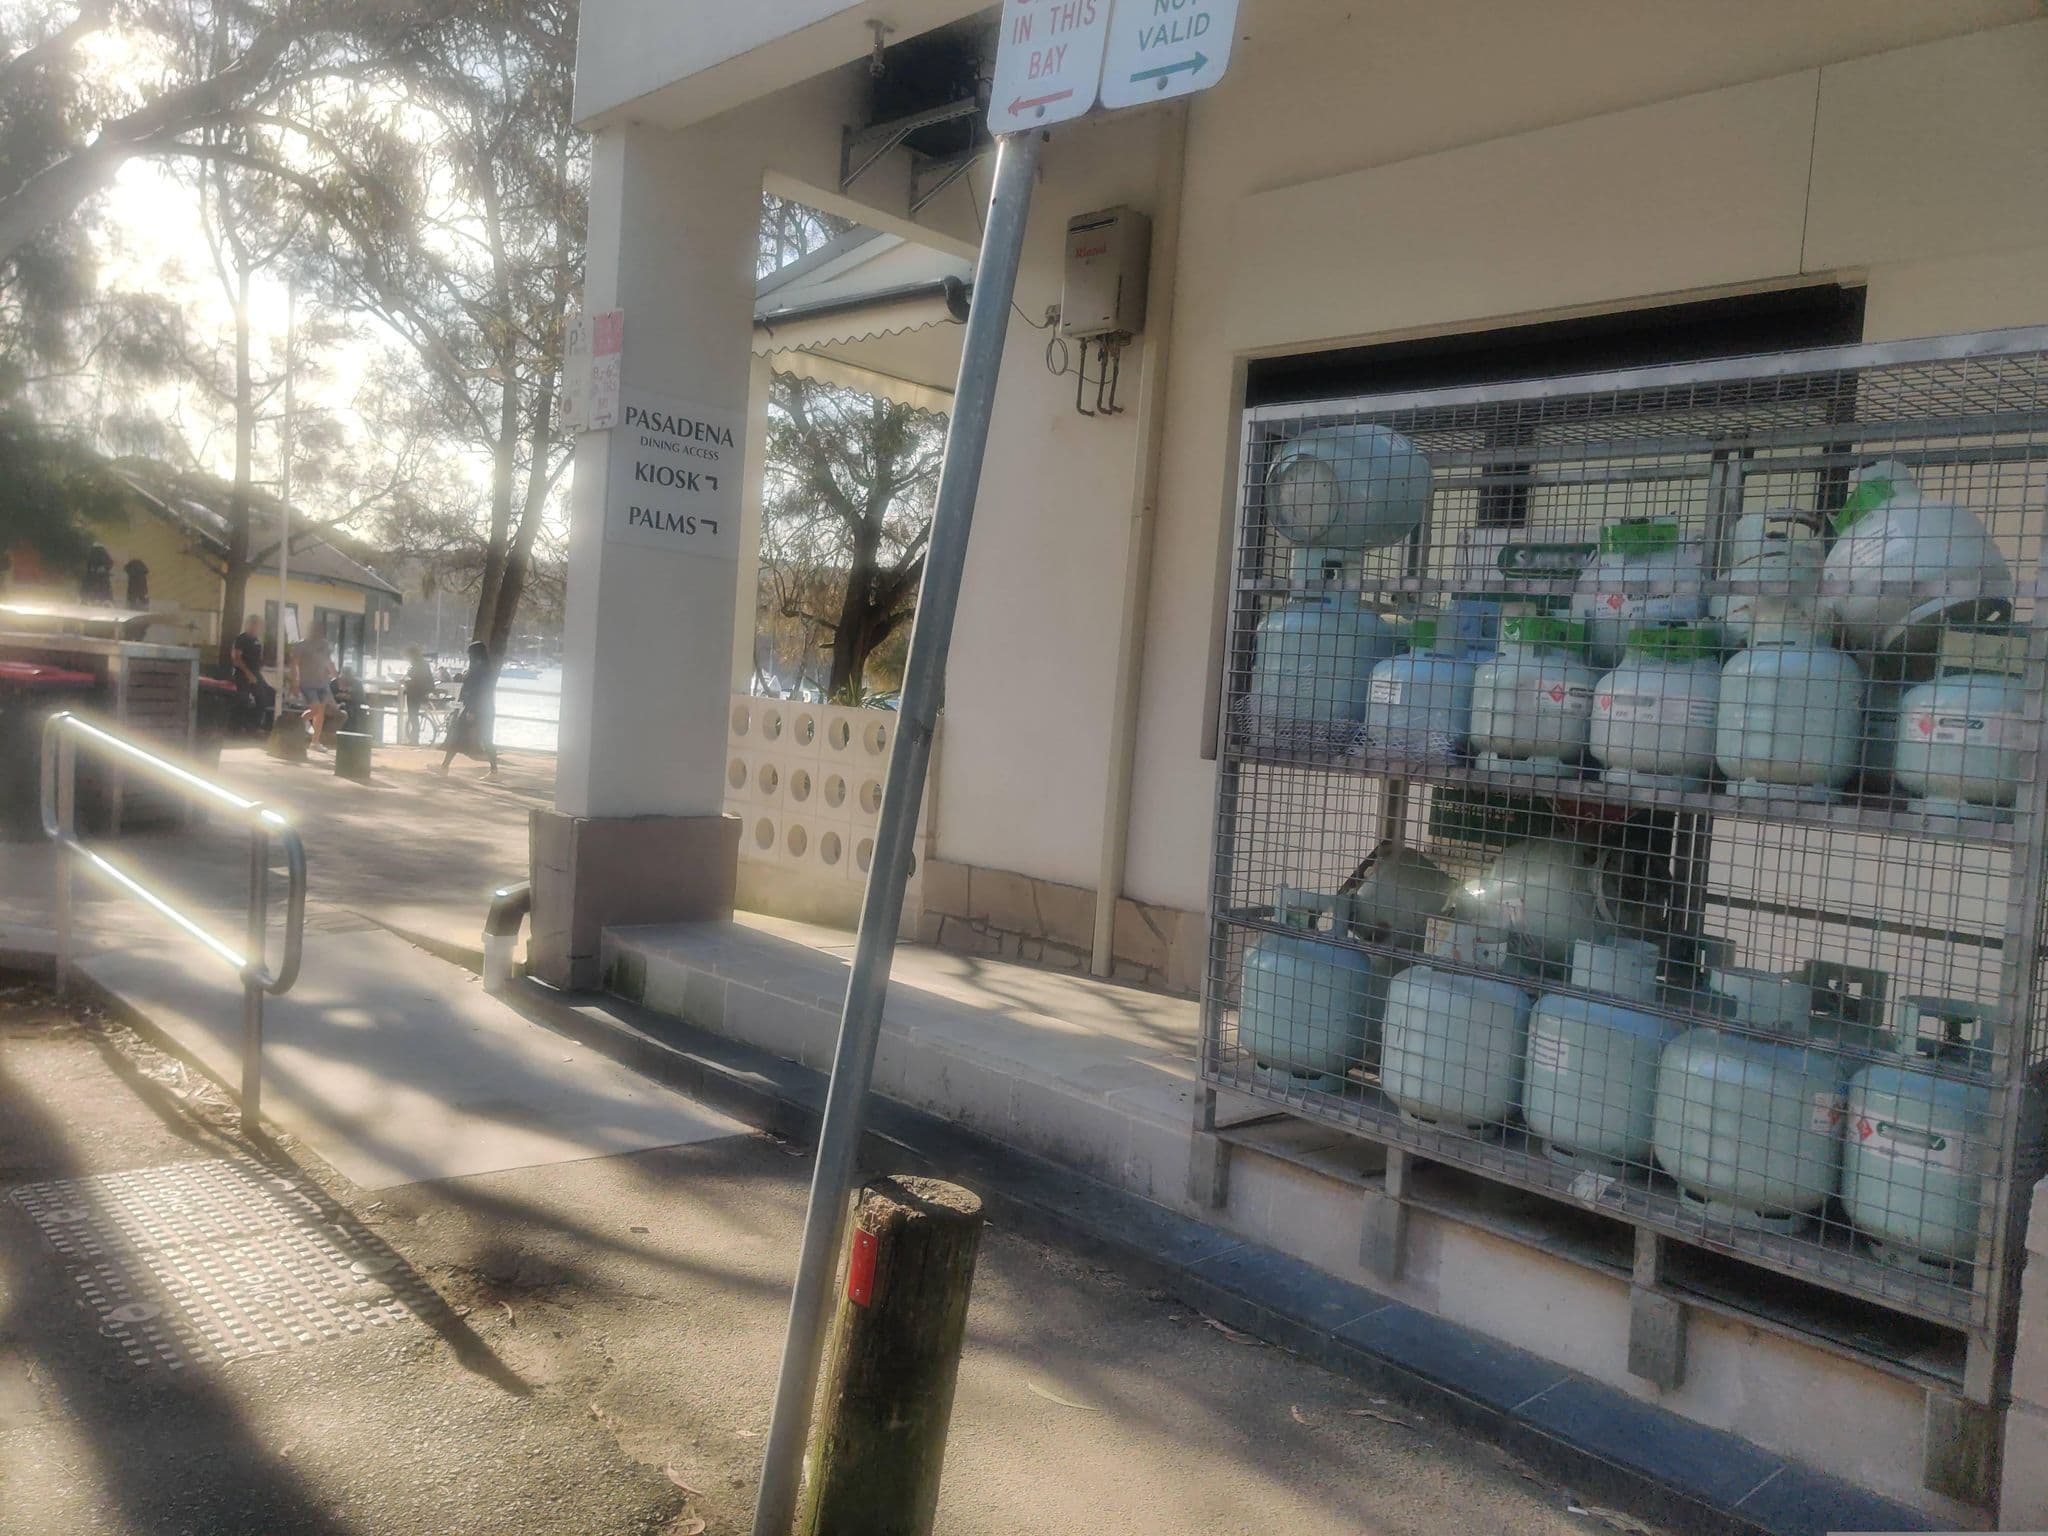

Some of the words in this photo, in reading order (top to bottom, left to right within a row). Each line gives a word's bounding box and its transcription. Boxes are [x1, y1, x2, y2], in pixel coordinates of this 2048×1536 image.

[1012, 13, 1033, 46] IN
[1050, 0, 1096, 35] THIS
[1139, 12, 1210, 51] VALID
[1027, 43, 1068, 80] BAY
[625, 406, 734, 448] PASADENA
[640, 435, 680, 453] DINING
[683, 445, 720, 461] ACCESS
[635, 461, 700, 492] KIOSK
[629, 506, 696, 536] PALMS
